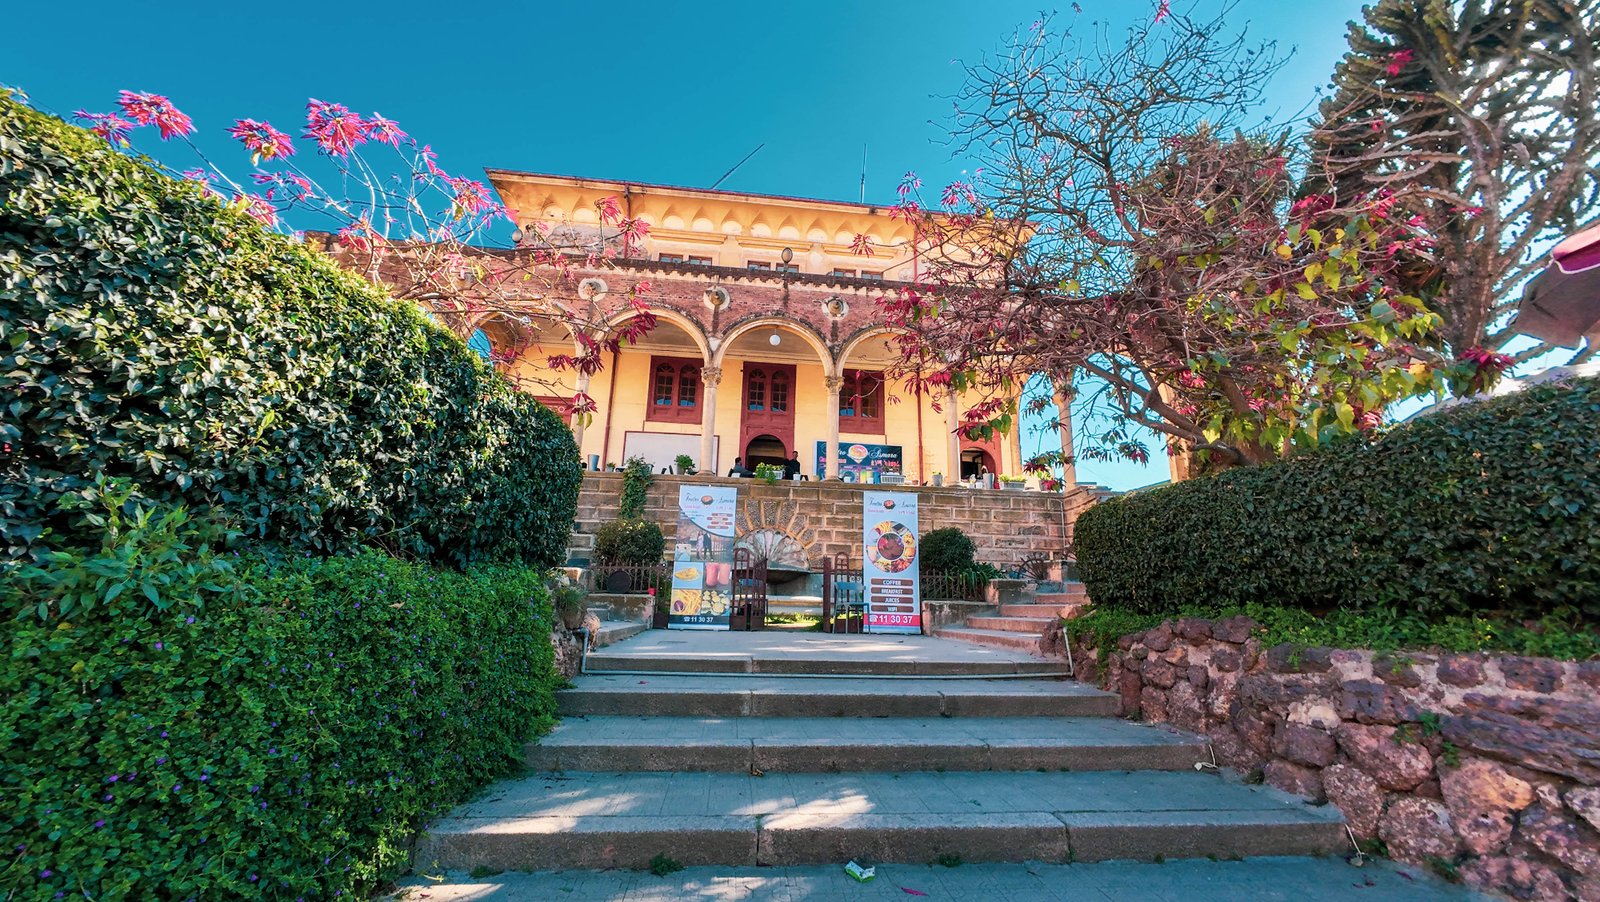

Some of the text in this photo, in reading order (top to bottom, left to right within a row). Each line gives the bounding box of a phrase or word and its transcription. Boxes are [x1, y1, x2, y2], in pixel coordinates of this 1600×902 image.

[879, 615, 913, 624] 11 30 37
